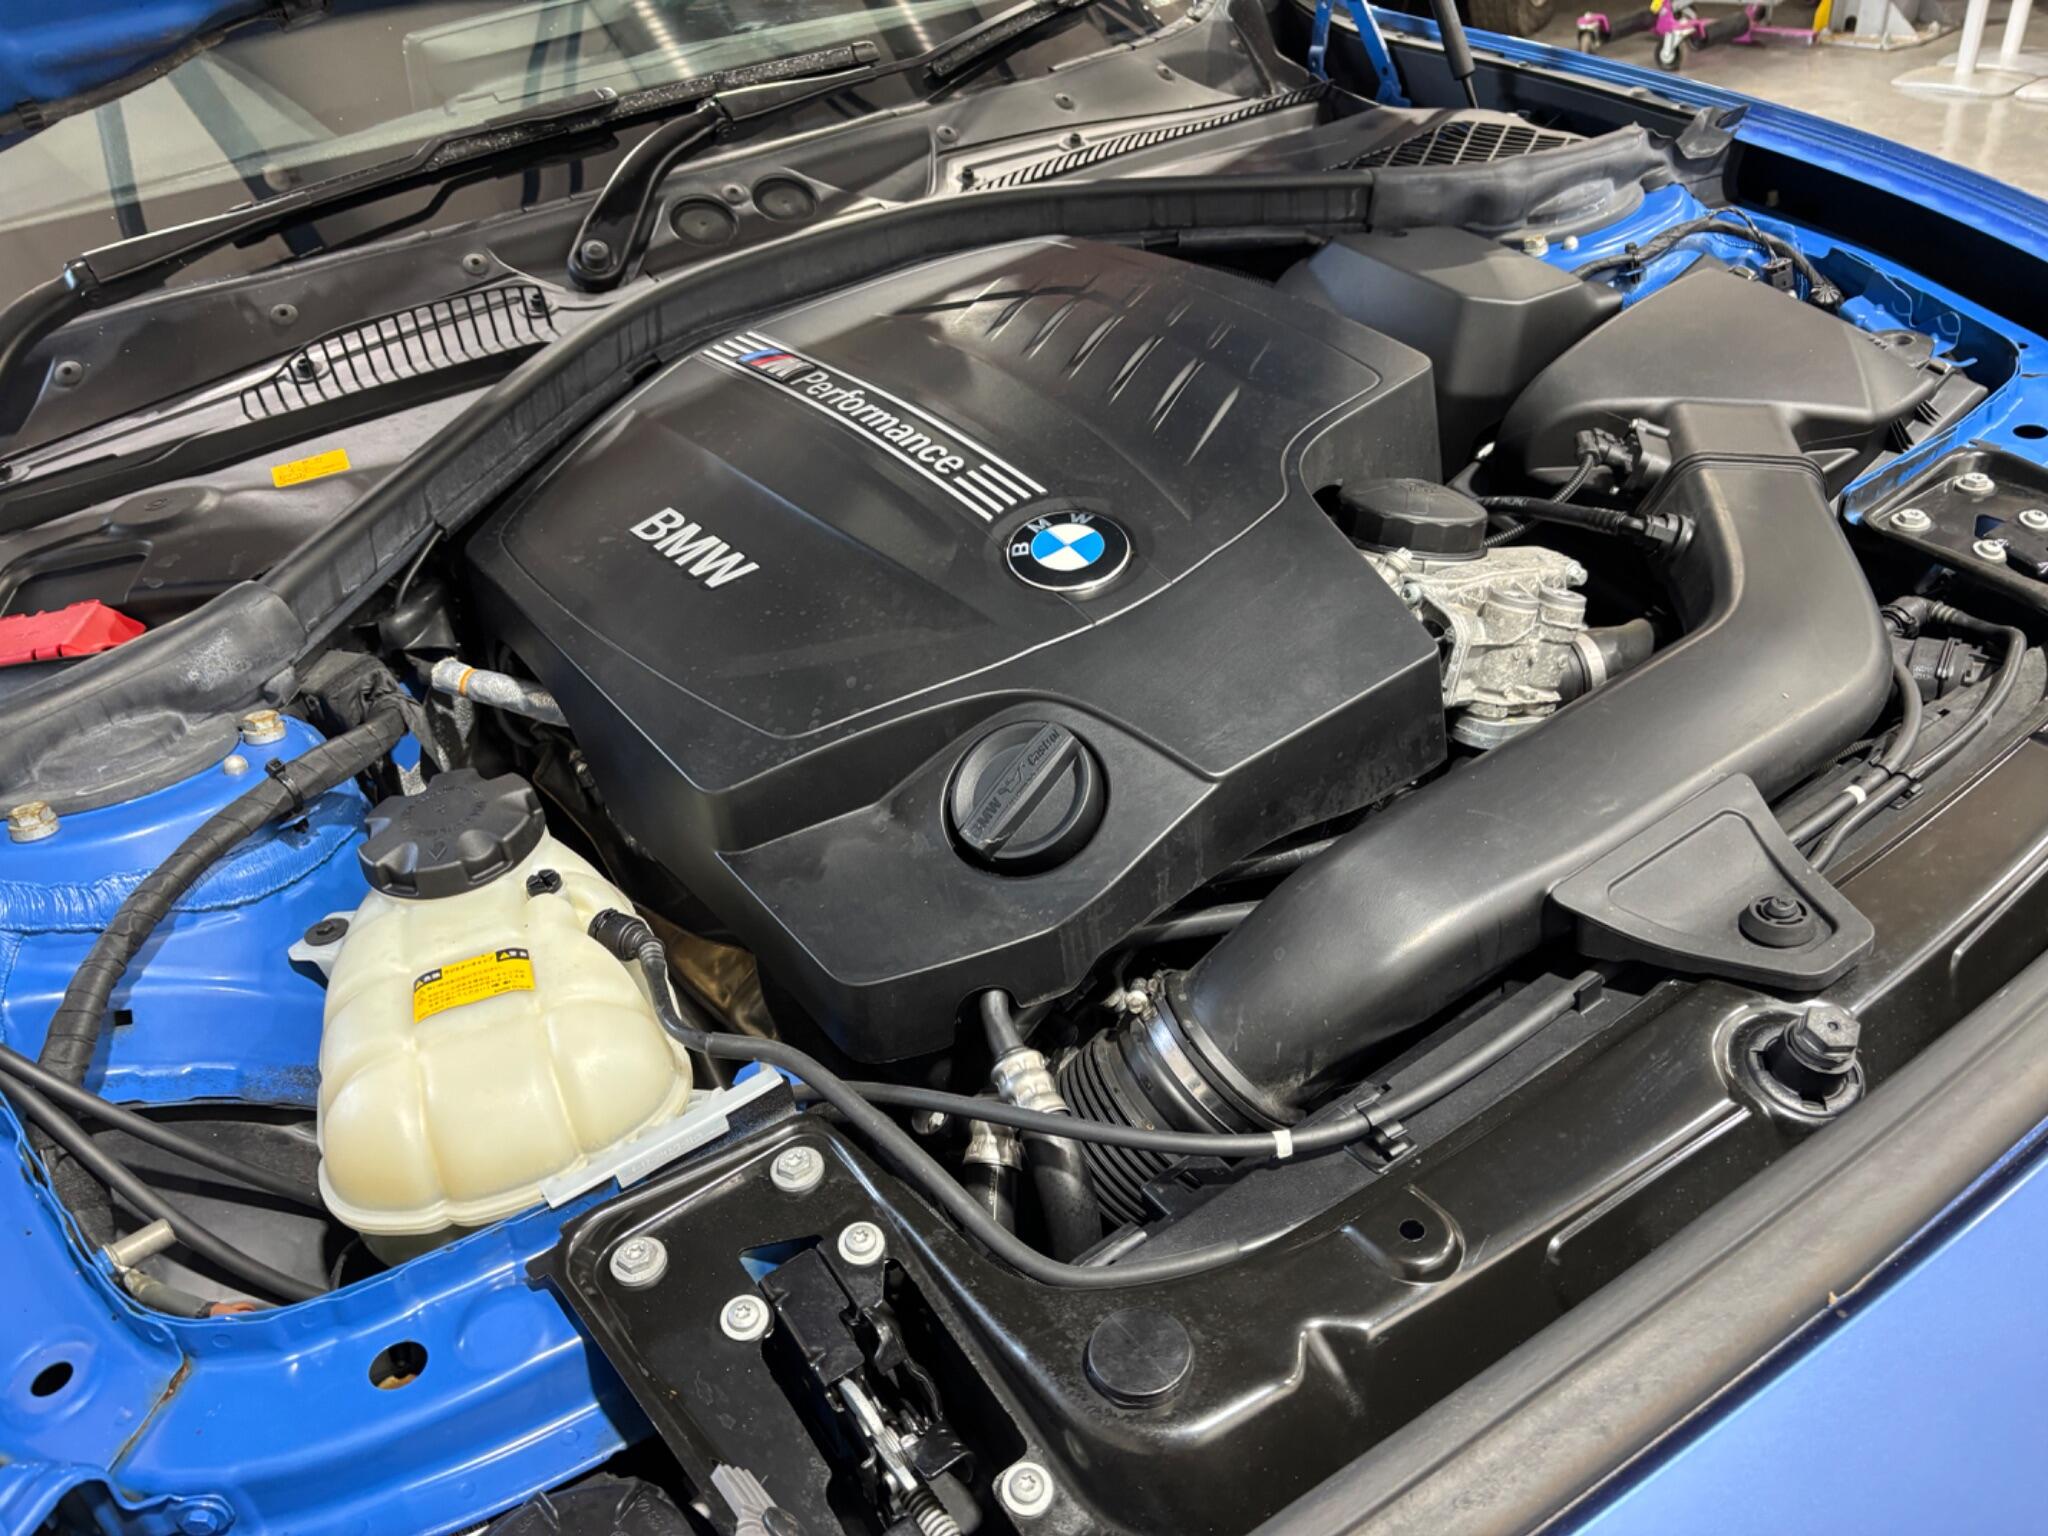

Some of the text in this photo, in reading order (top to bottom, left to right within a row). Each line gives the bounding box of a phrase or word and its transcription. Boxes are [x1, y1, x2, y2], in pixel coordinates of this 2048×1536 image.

[790, 370, 965, 474] Performance
[629, 507, 760, 588] BMW
[1011, 513, 1095, 557] BMW
[973, 728, 1060, 838] BMW Castrol
